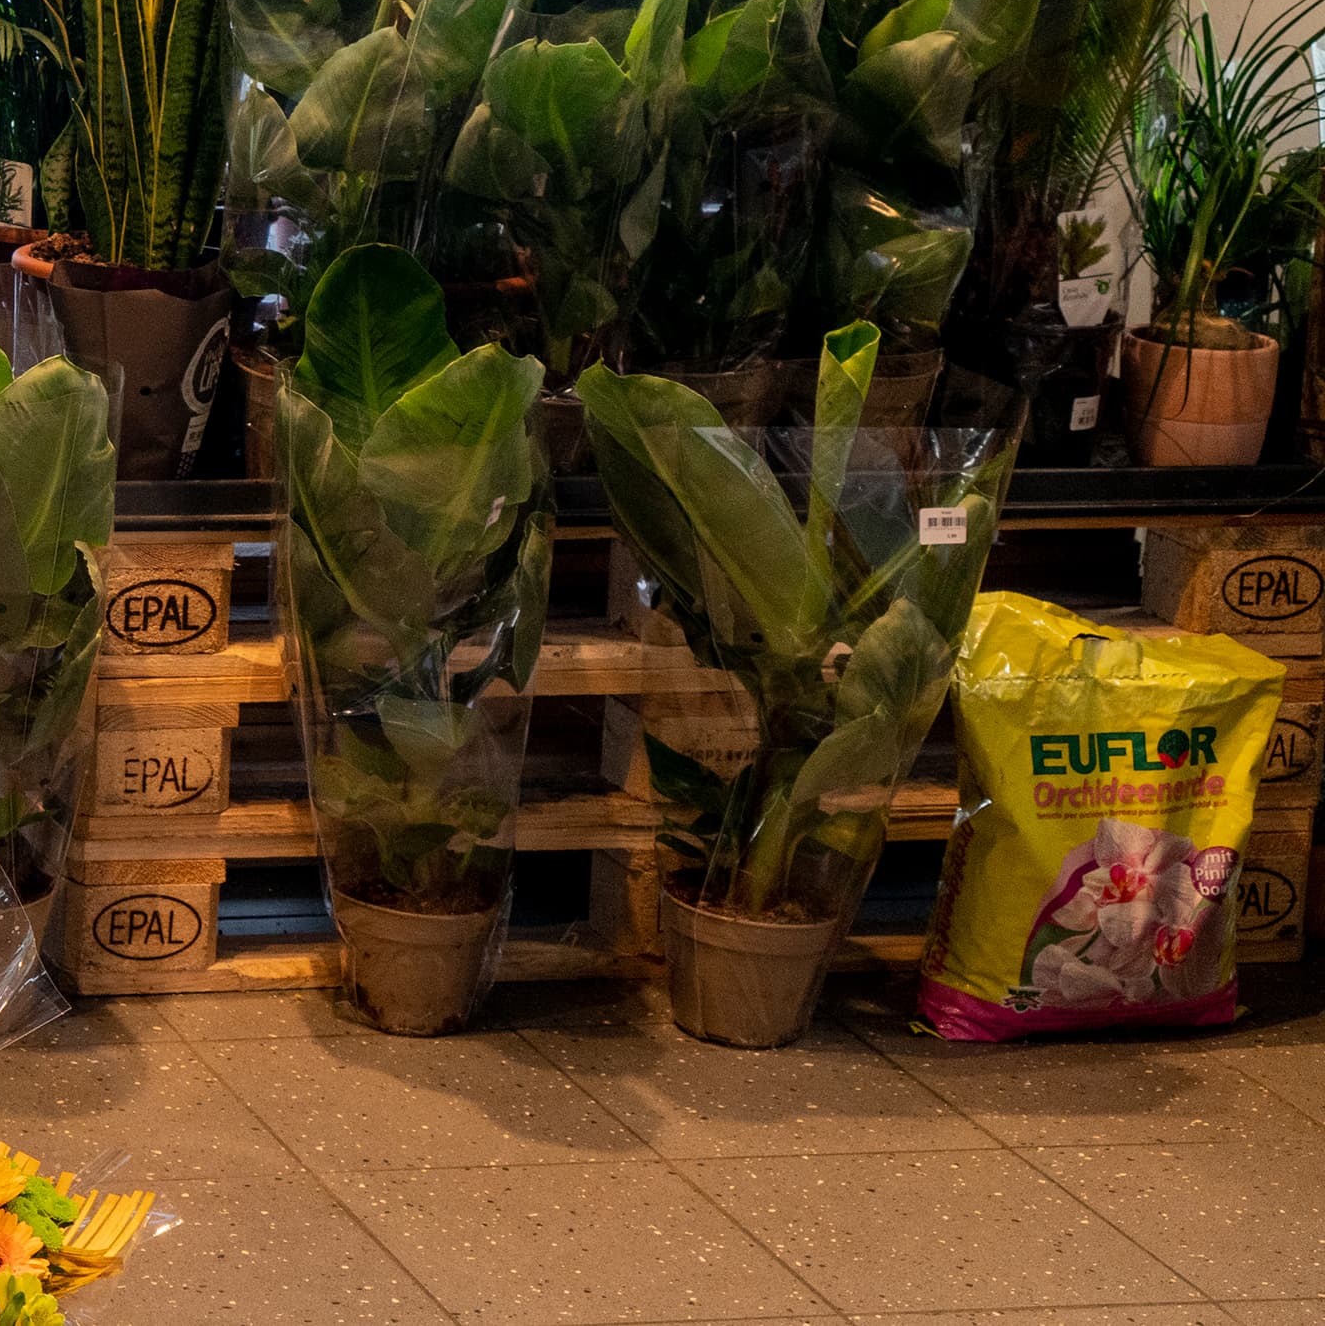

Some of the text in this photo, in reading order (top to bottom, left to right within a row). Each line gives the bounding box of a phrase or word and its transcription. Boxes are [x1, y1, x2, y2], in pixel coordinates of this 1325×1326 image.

[1237, 570, 1308, 607] EPAL
[123, 594, 200, 633] EPAL
[1031, 727, 1218, 775] EUFLOR
[1266, 733, 1302, 769] AL
[123, 756, 199, 793] EPAL
[1034, 770, 1226, 809] Orchideenerde
[1205, 850, 1232, 864] mit
[109, 910, 185, 945] EPAL
